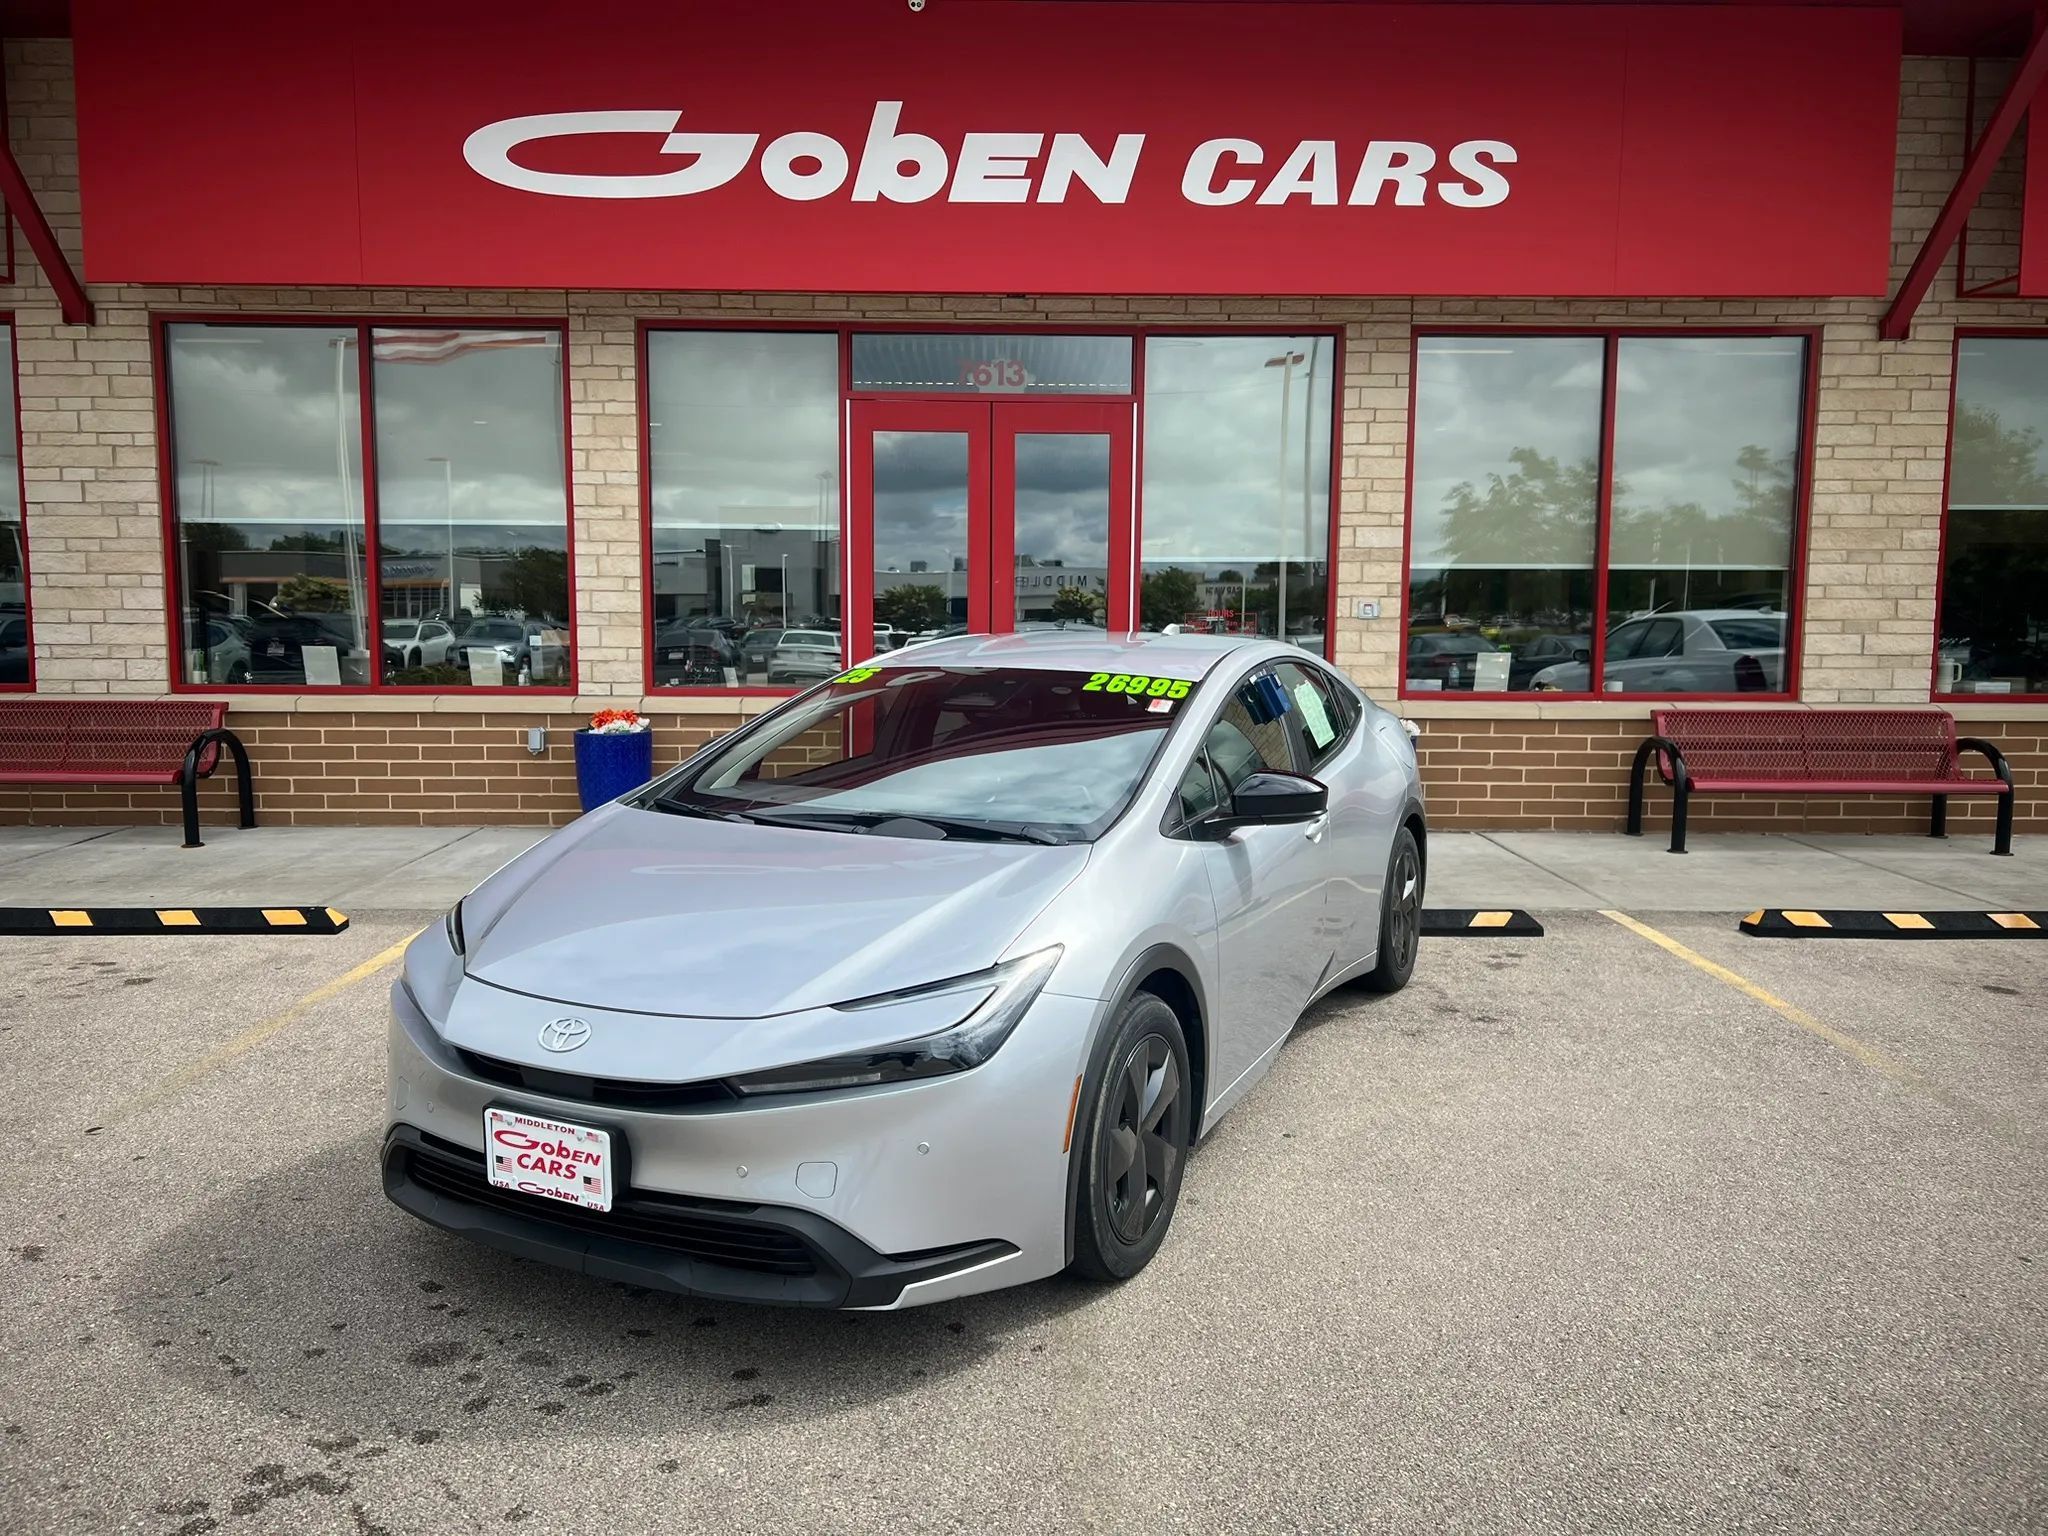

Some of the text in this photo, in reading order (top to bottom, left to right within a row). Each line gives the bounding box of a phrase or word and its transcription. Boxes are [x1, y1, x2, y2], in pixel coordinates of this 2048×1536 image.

[1181, 138, 1518, 208] CARS
[1083, 673, 1192, 699] 26995
[514, 1116, 575, 1135] MIDDLETON
[517, 1153, 577, 1180] CARS
[492, 1180, 510, 1190] USA
[586, 1201, 605, 1211] USA
